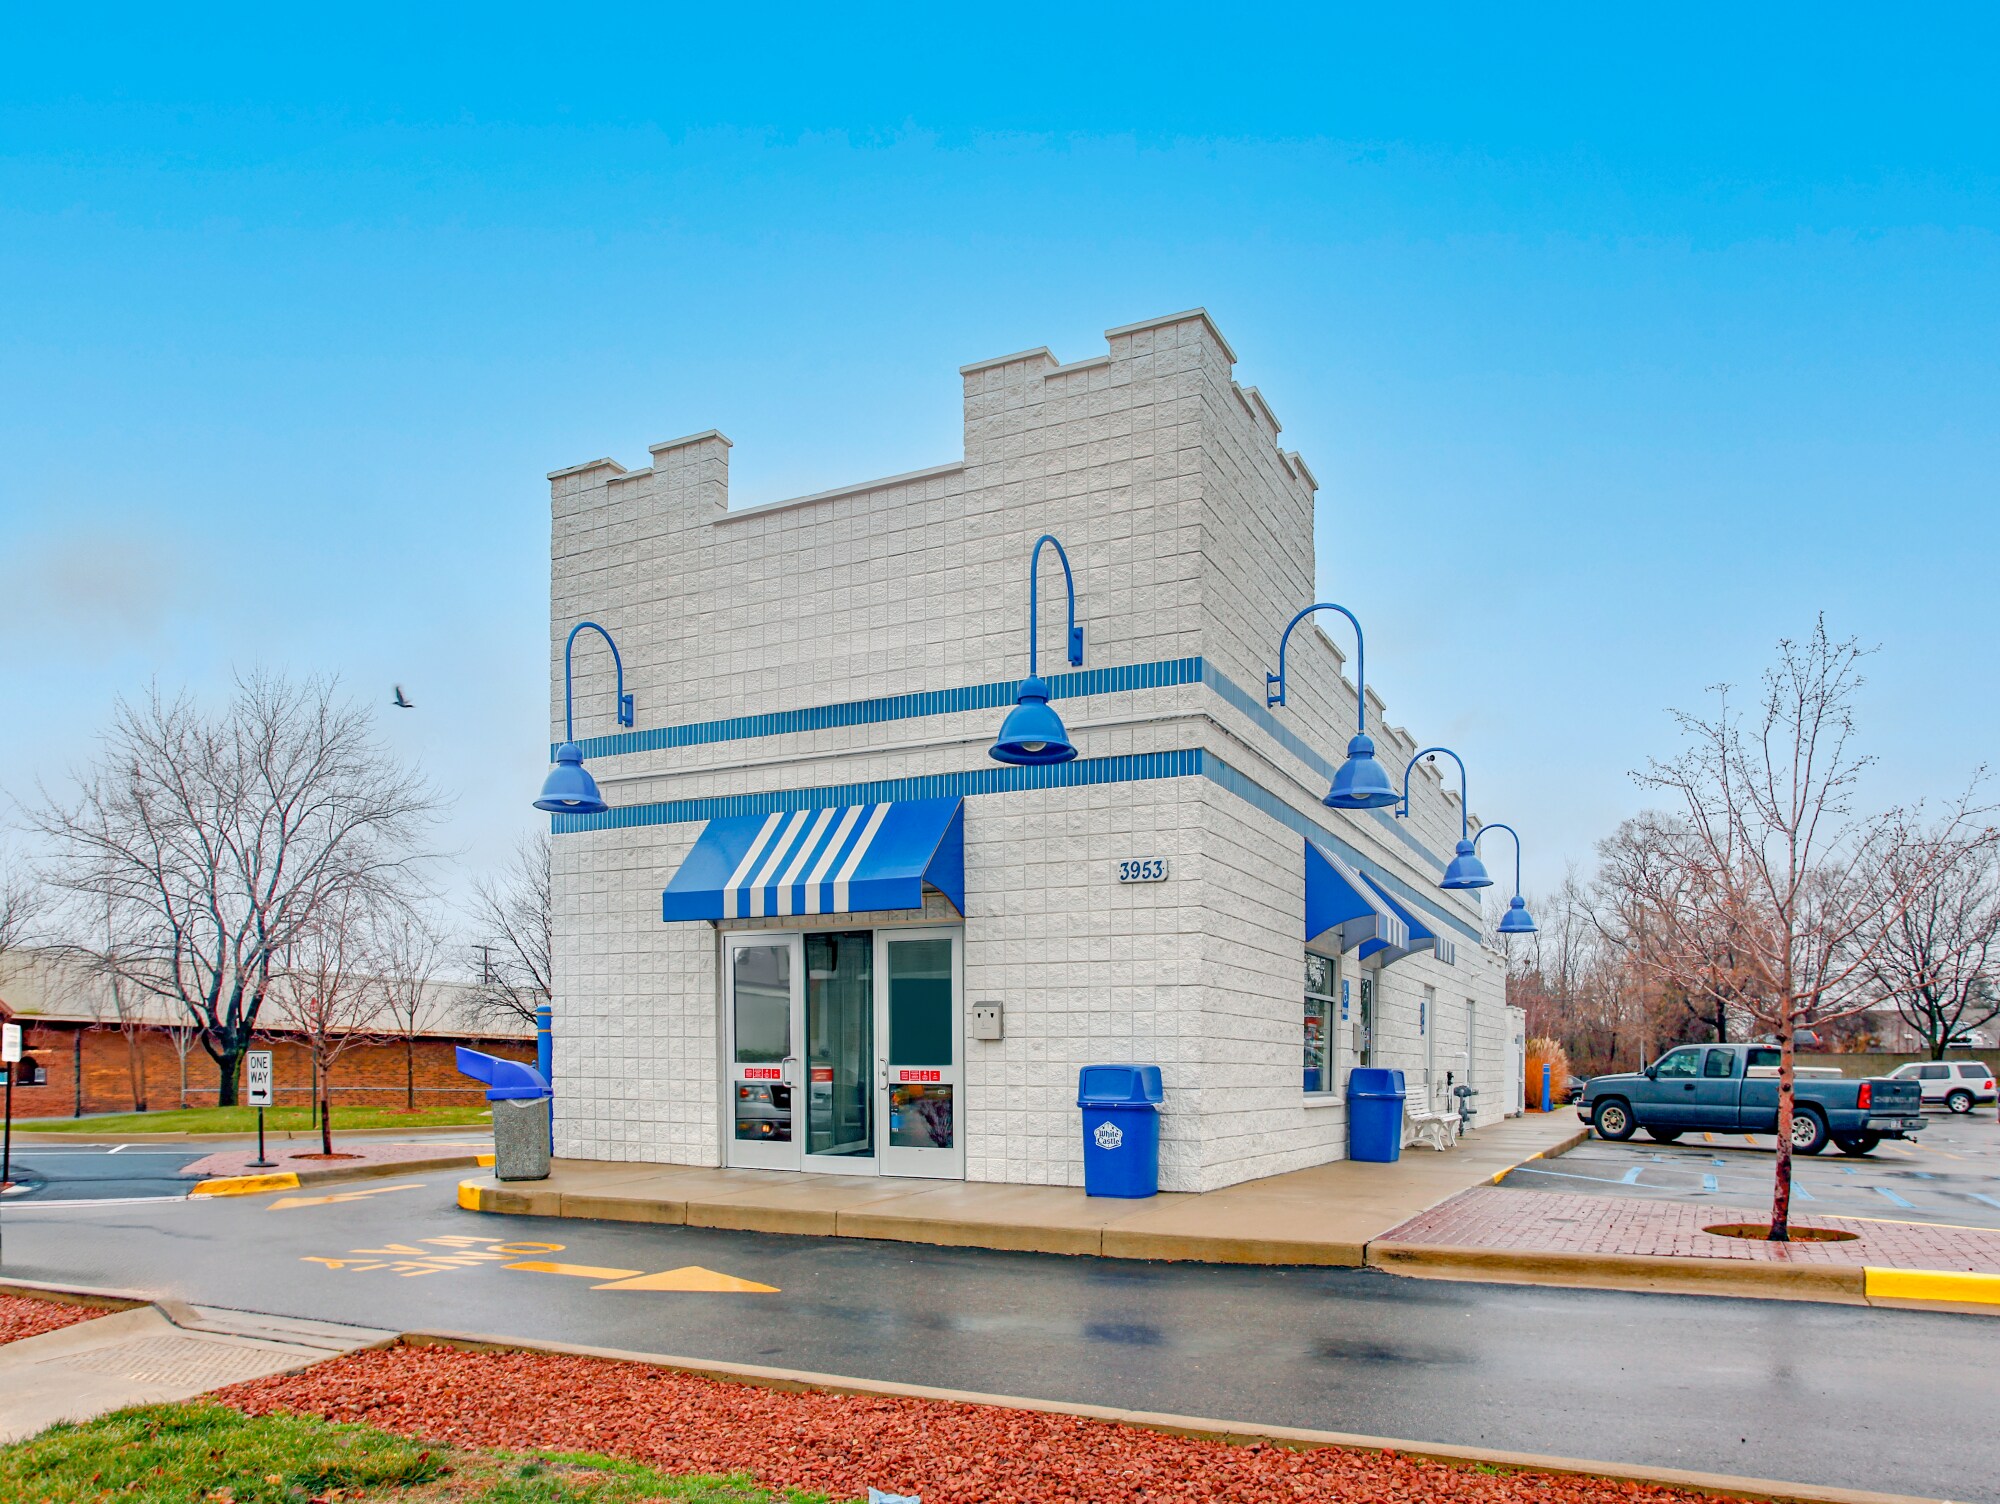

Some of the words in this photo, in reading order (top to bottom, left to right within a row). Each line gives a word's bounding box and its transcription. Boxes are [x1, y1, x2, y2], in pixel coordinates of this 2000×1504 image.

[1120, 860, 1163, 881] 3953
[250, 1056, 268, 1069] ONE
[250, 1071, 268, 1084] WAY
[1098, 1130, 1119, 1138] White
